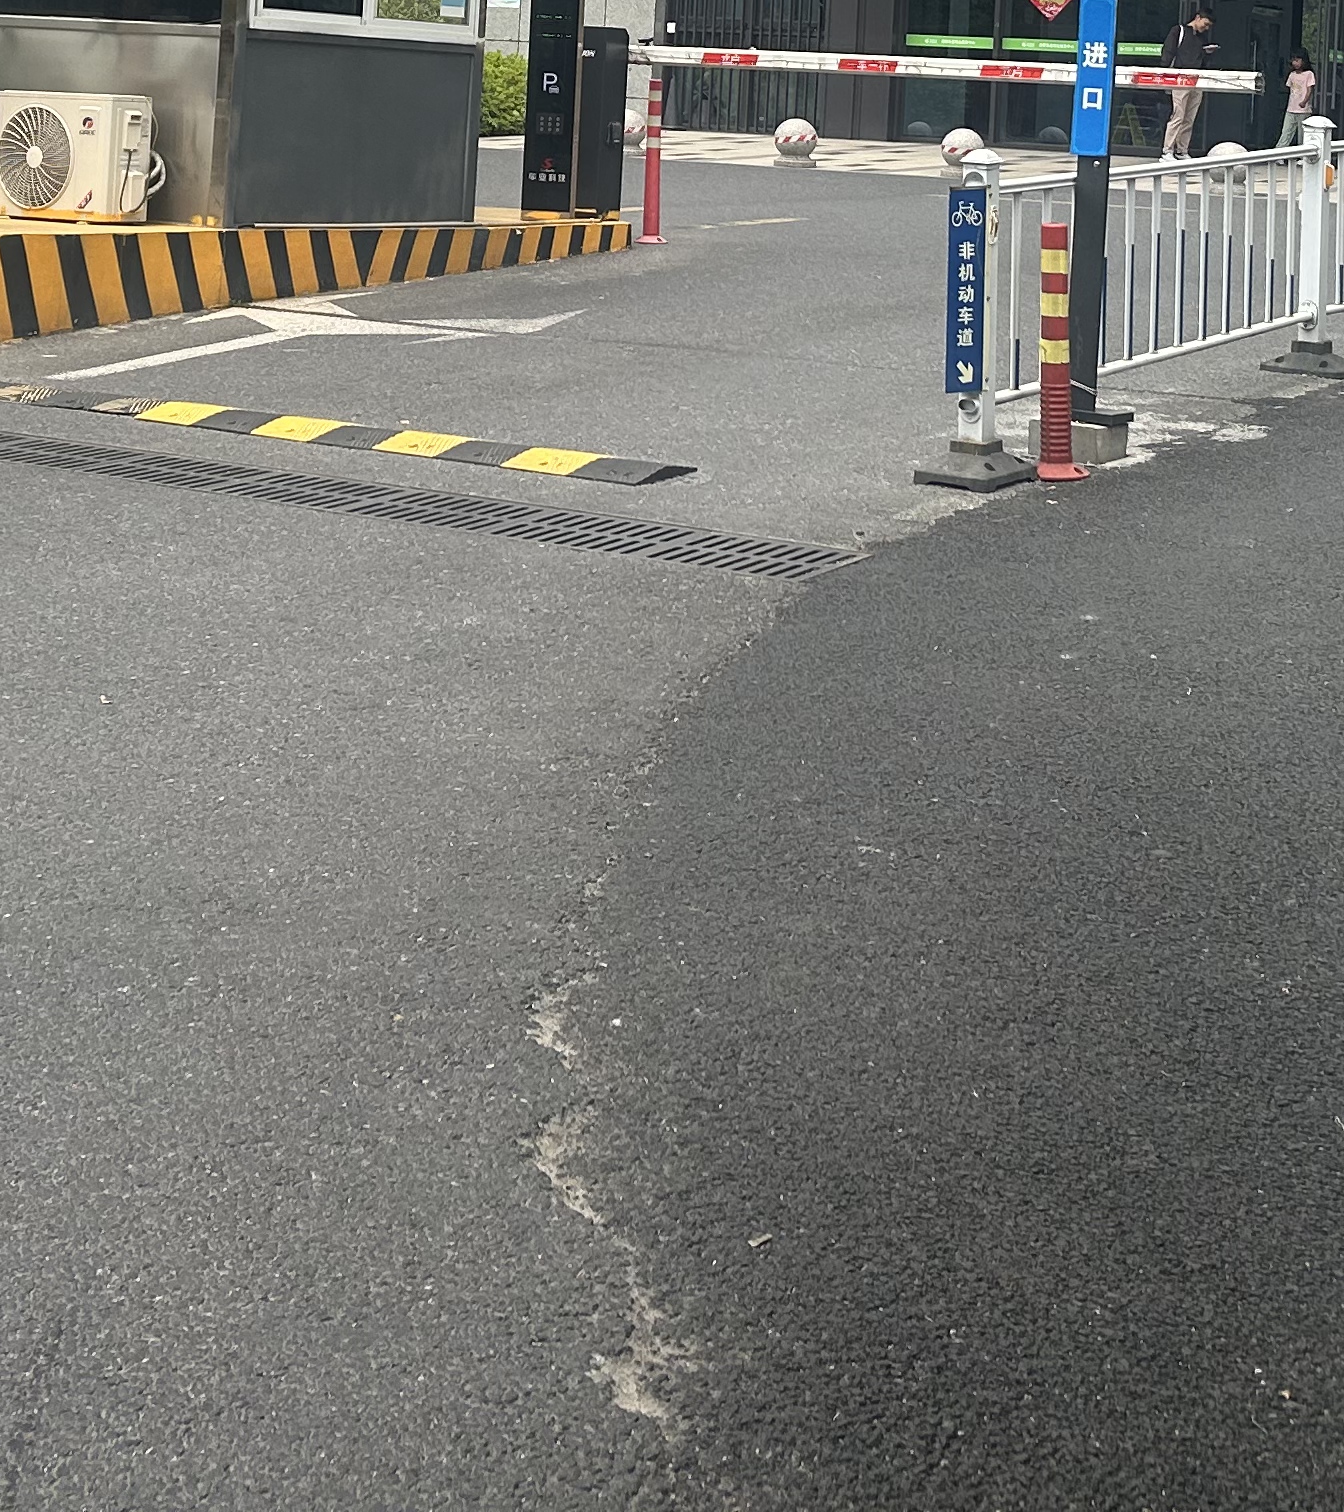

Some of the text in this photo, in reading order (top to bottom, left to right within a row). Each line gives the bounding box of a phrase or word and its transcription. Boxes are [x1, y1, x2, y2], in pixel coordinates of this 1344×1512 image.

[1082, 41, 1109, 110] 进口
[957, 241, 975, 347] 非机动车道
